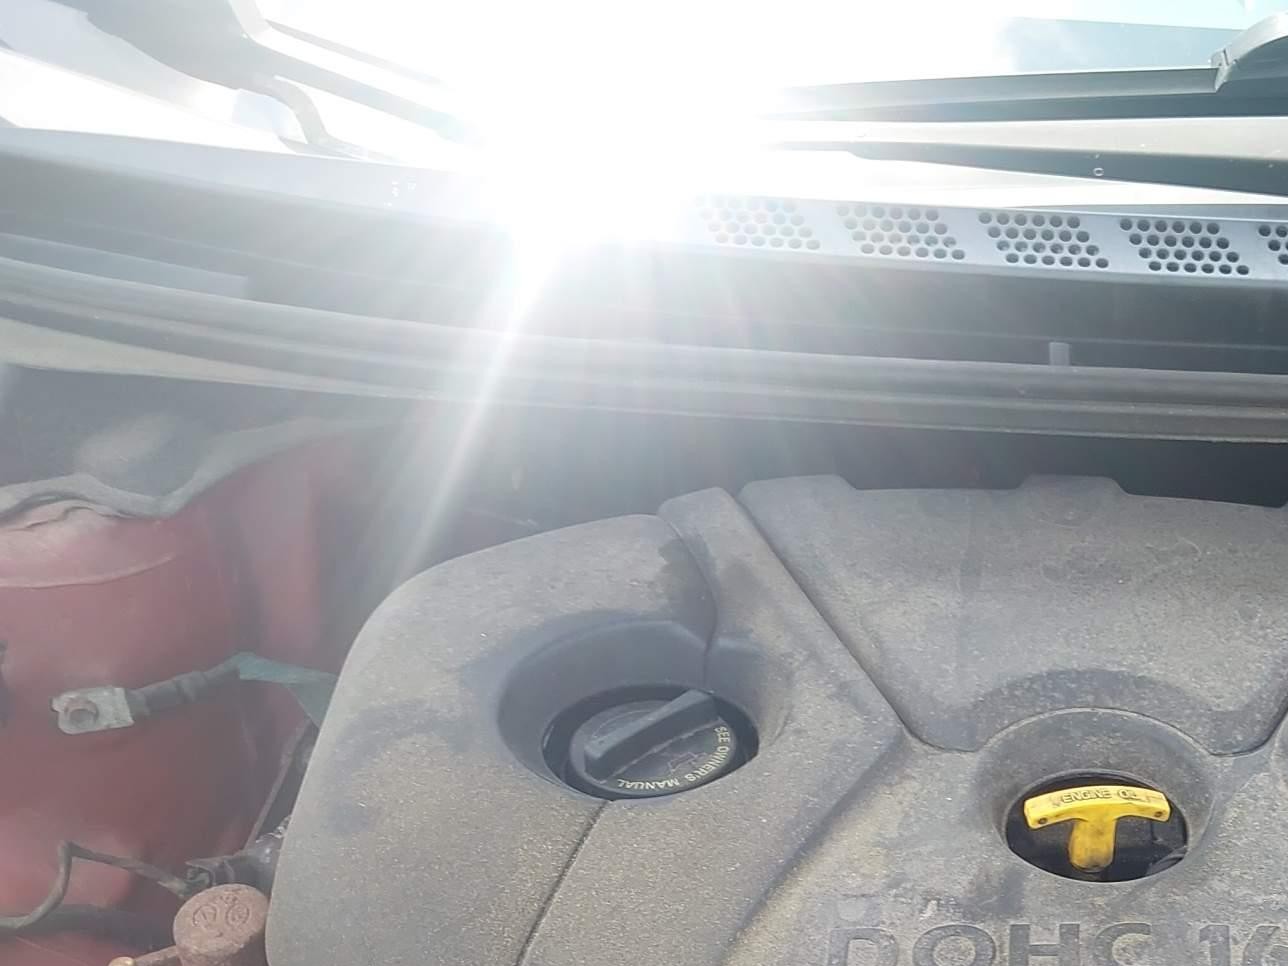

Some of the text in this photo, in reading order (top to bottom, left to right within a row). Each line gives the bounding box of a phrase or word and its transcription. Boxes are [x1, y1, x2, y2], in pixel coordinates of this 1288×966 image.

[617, 725, 731, 790] SEE OWNER'S MANUAL
[1060, 789, 1112, 804] ENGINE
